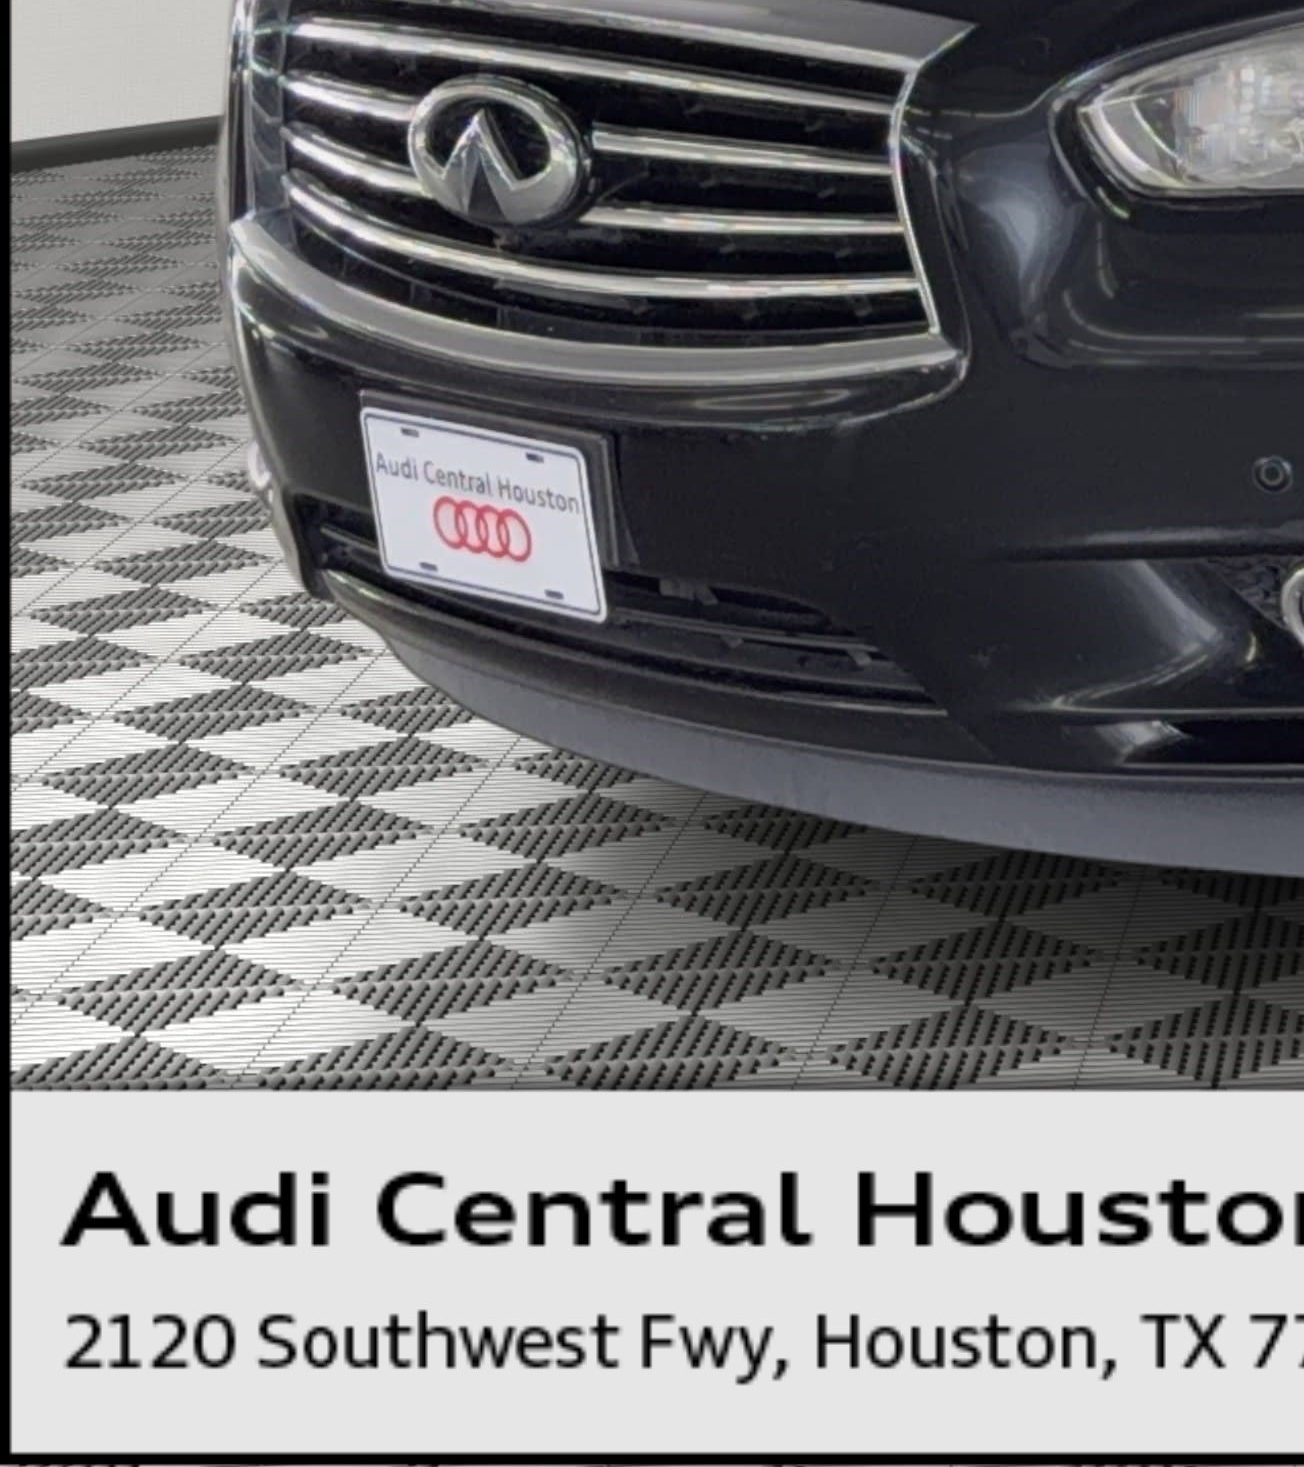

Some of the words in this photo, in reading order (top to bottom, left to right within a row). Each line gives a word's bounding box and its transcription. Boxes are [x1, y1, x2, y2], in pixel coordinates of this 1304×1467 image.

[376, 452, 418, 480] Audi
[423, 460, 493, 497] Central
[499, 474, 579, 514] Houston
